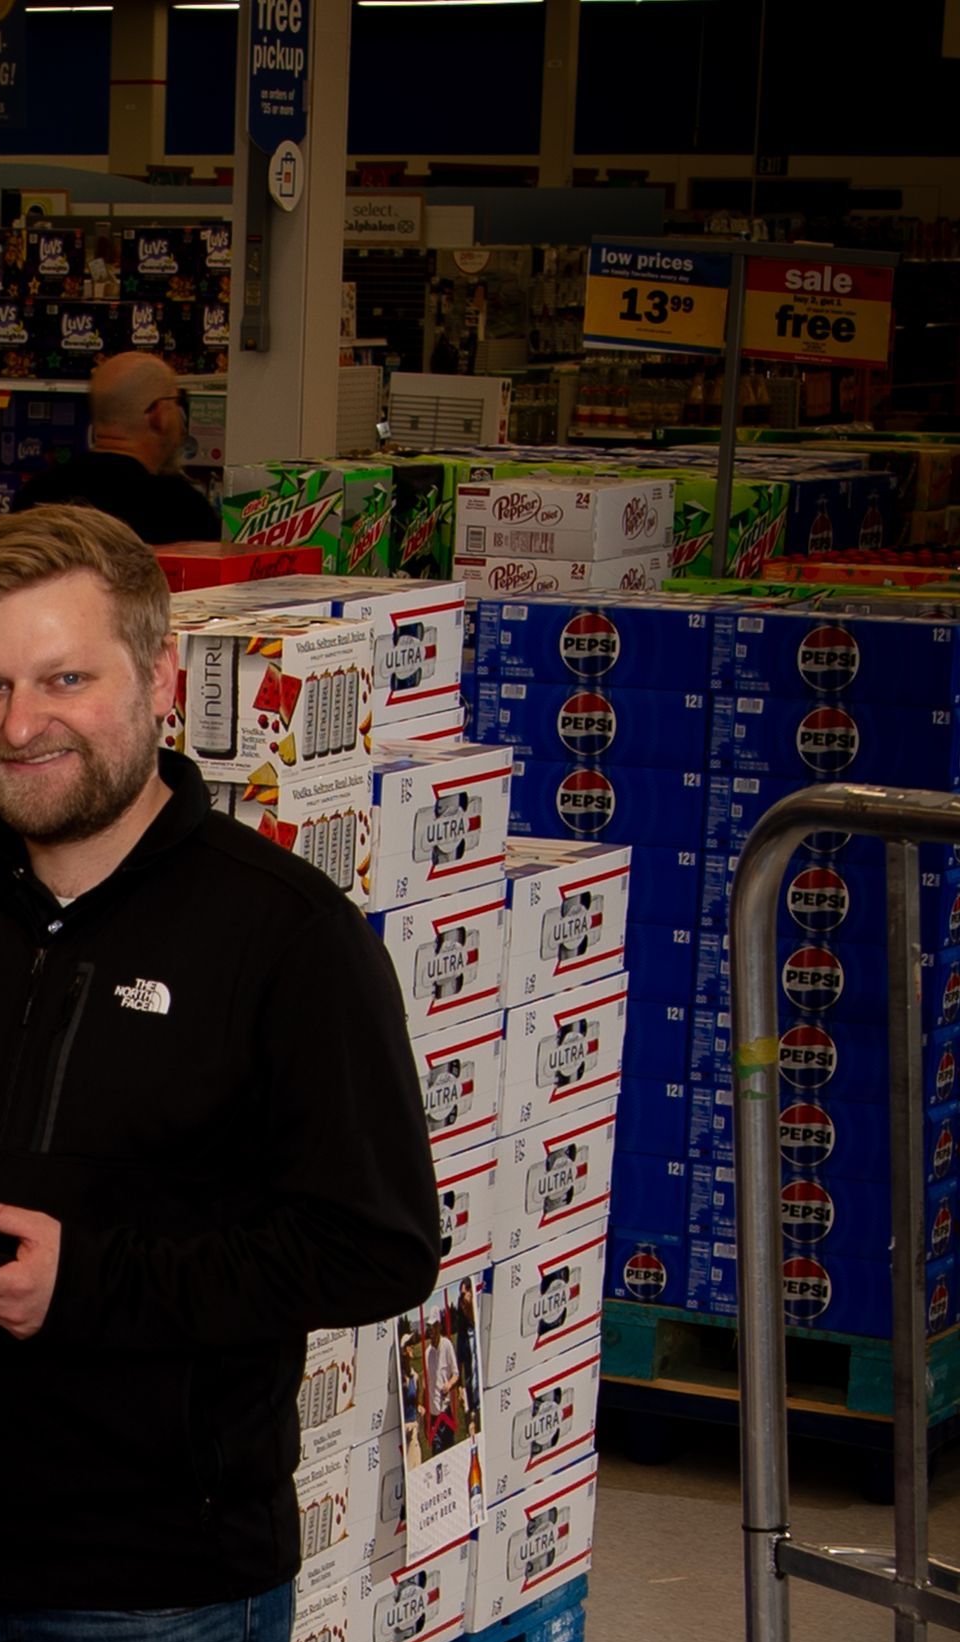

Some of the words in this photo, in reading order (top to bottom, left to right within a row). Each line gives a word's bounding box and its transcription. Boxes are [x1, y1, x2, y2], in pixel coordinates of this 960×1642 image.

[257, 0, 303, 33] free
[253, 36, 304, 78] pickup
[352, 202, 392, 217] select
[601, 248, 631, 265] low
[637, 252, 693, 274] prices
[785, 265, 852, 294] sale
[776, 305, 856, 342] free
[509, 493, 525, 507] Dr
[576, 493, 590, 504] 24
[497, 496, 538, 521] Pepper
[564, 638, 616, 653] PEPSI
[386, 649, 421, 669] ULTRA
[802, 652, 855, 668] PEPSI
[562, 717, 613, 732] PEPSI
[427, 820, 466, 842] ULTRA
[135, 977, 157, 991] THE
[786, 971, 840, 987] PEPSI
[114, 984, 152, 1002] NORTH
[120, 997, 150, 1012] FACE
[548, 1044, 585, 1070] ULTRA
[627, 1268, 664, 1282] PEPSI
[387, 1597, 426, 1629] ULTRA
